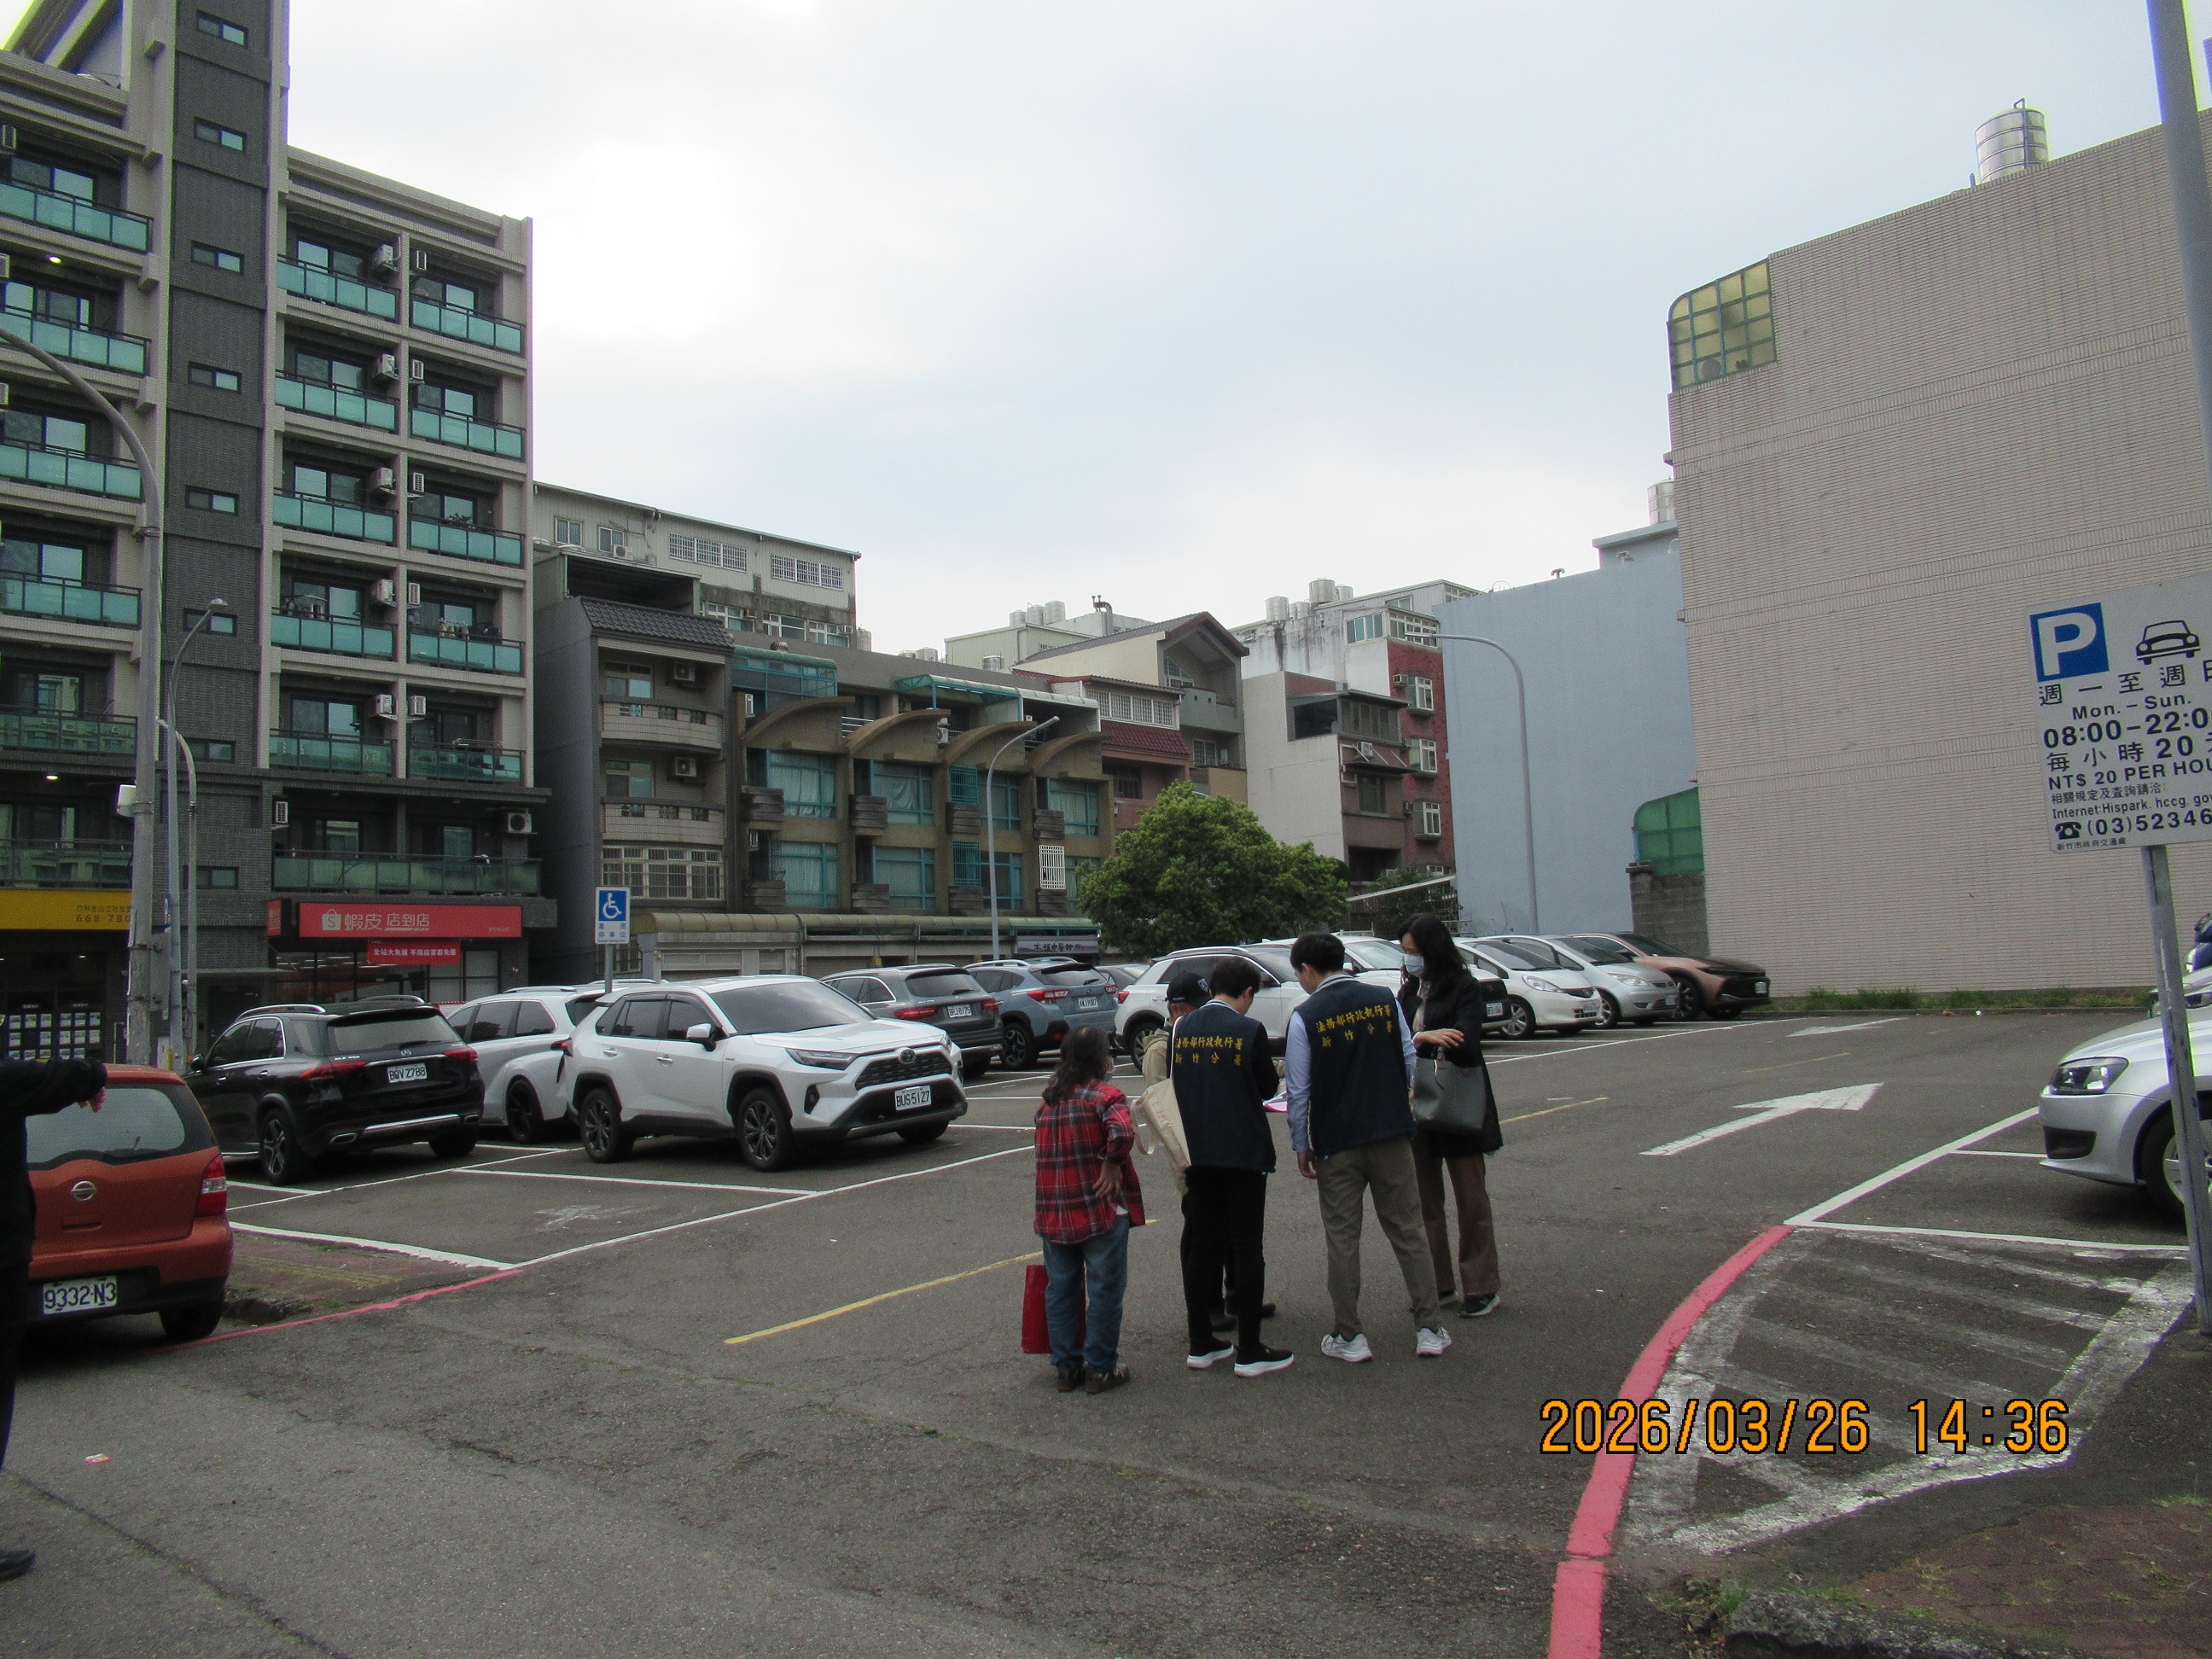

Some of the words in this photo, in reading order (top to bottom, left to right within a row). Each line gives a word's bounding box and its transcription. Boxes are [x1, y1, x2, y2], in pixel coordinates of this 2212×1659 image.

[2037, 612, 2097, 676] P
[2043, 707, 2212, 748] 08:00-22:0
[2094, 770, 2117, 784] 20
[2124, 764, 2165, 781] PER
[344, 913, 383, 930] 蝦皮
[387, 913, 430, 928] 店到店
[1316, 1004, 1391, 1033] 法務部行政執行署
[44, 1282, 116, 1309] 9332-N3
